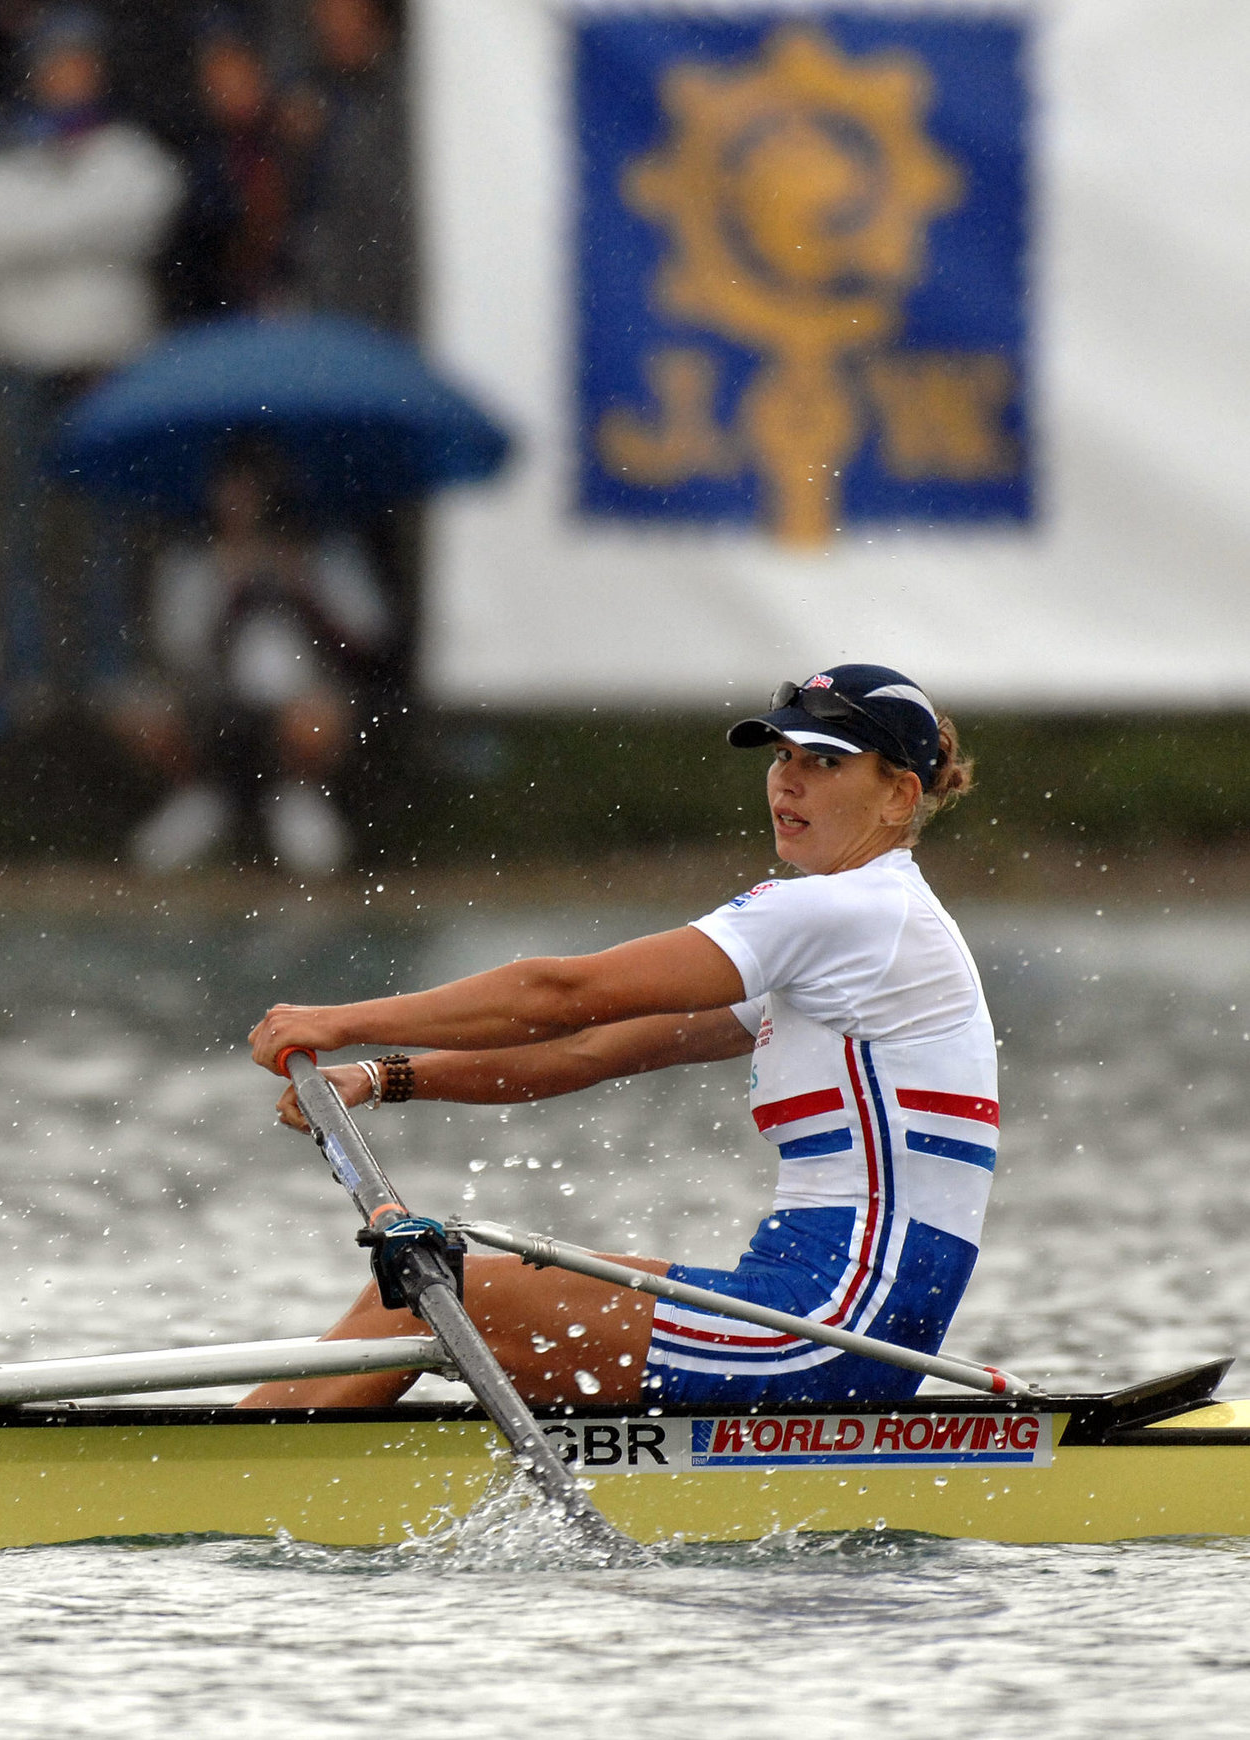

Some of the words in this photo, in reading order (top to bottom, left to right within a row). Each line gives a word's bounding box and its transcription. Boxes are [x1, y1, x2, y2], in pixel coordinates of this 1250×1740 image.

[543, 1423, 669, 1466] GBR
[711, 1418, 864, 1454] WORLD
[873, 1417, 1040, 1451] ROWING
